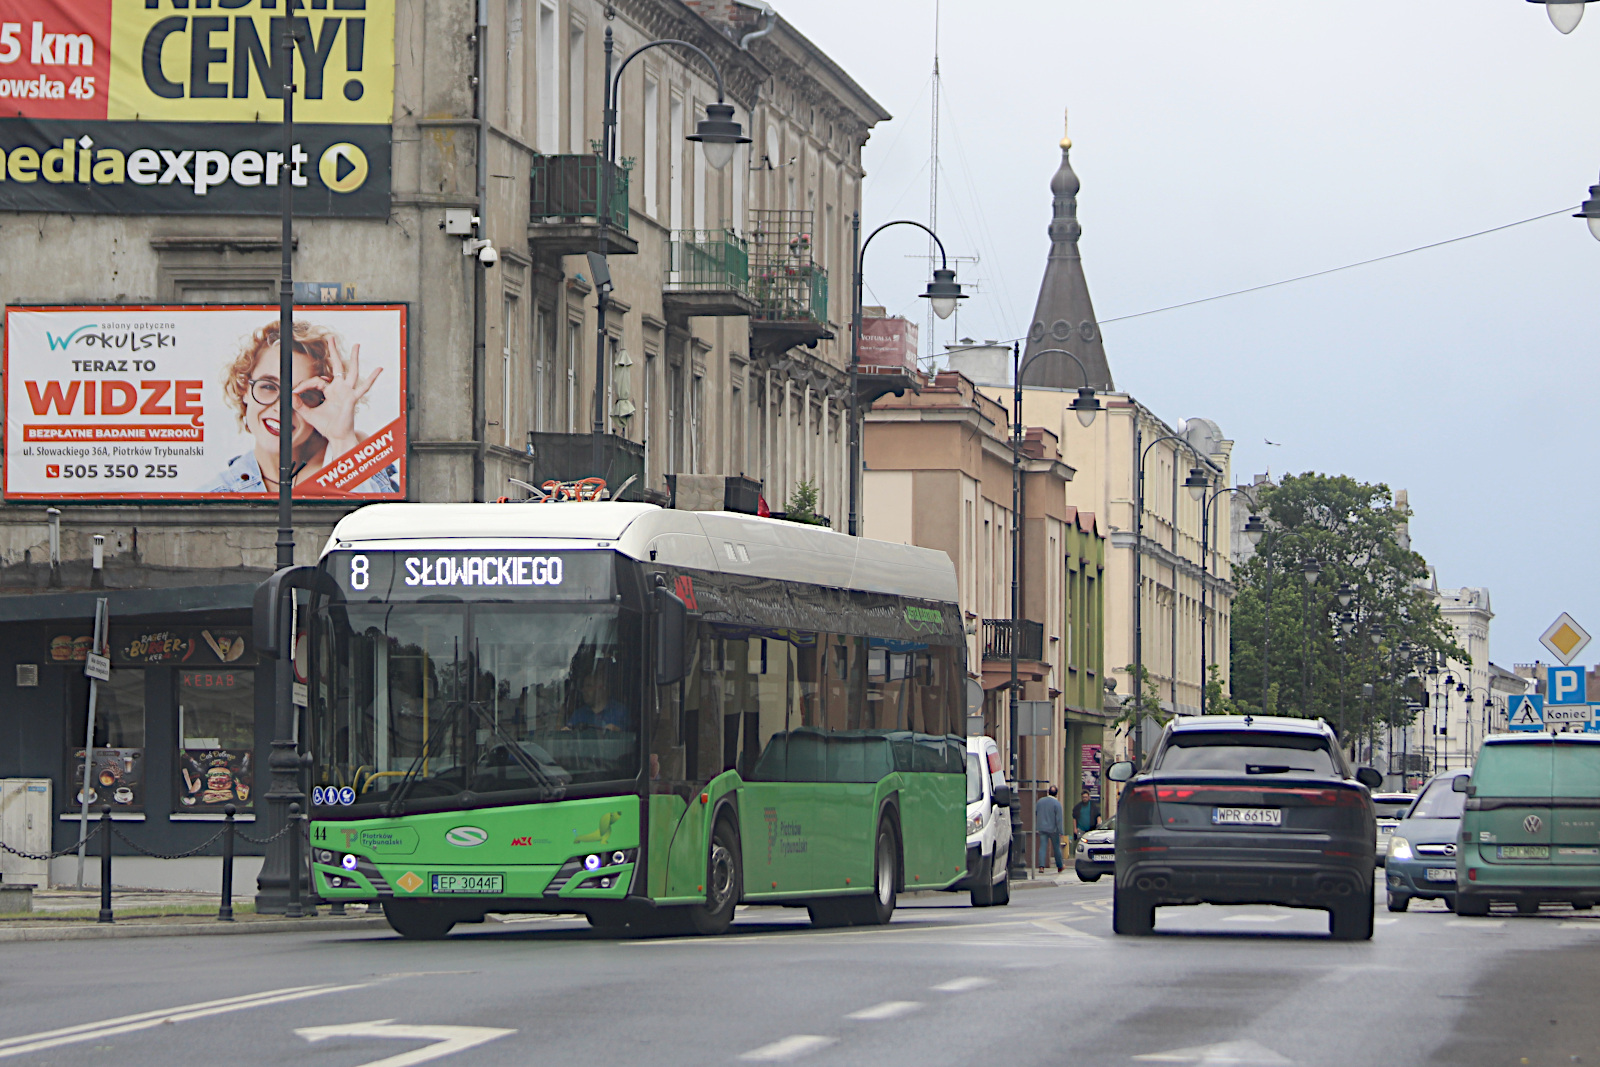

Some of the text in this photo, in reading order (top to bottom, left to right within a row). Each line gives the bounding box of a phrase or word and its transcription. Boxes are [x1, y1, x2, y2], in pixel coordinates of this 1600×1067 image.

[31, 21, 94, 66] km
[141, 15, 366, 101] CENY!
[68, 76, 95, 99] 45
[101, 322, 175, 330] salony optyczne
[72, 359, 156, 372] TERAZ TO
[24, 380, 204, 427] WIDZĘ
[28, 428, 199, 439] BEZPŁATNE BADANIE WZROKU
[23, 445, 204, 459] ul. Słowackiego 36A, Piotrków Trybunalski
[316, 430, 394, 487] TWÓJ NOWY
[63, 464, 178, 479] 505 350 255
[335, 445, 394, 488] SALON OPTYCZNY
[351, 555, 563, 590] 8 SŁOWACKIEGO
[130, 638, 181, 657] BURGER
[184, 674, 235, 687] KEBAB
[1555, 670, 1578, 701] P
[1547, 708, 1586, 720] Koniec
[1219, 809, 1280, 822] WPR 6615V
[313, 826, 327, 841] 44
[362, 832, 393, 840] Piotrków
[440, 876, 499, 889] EP 3044F
